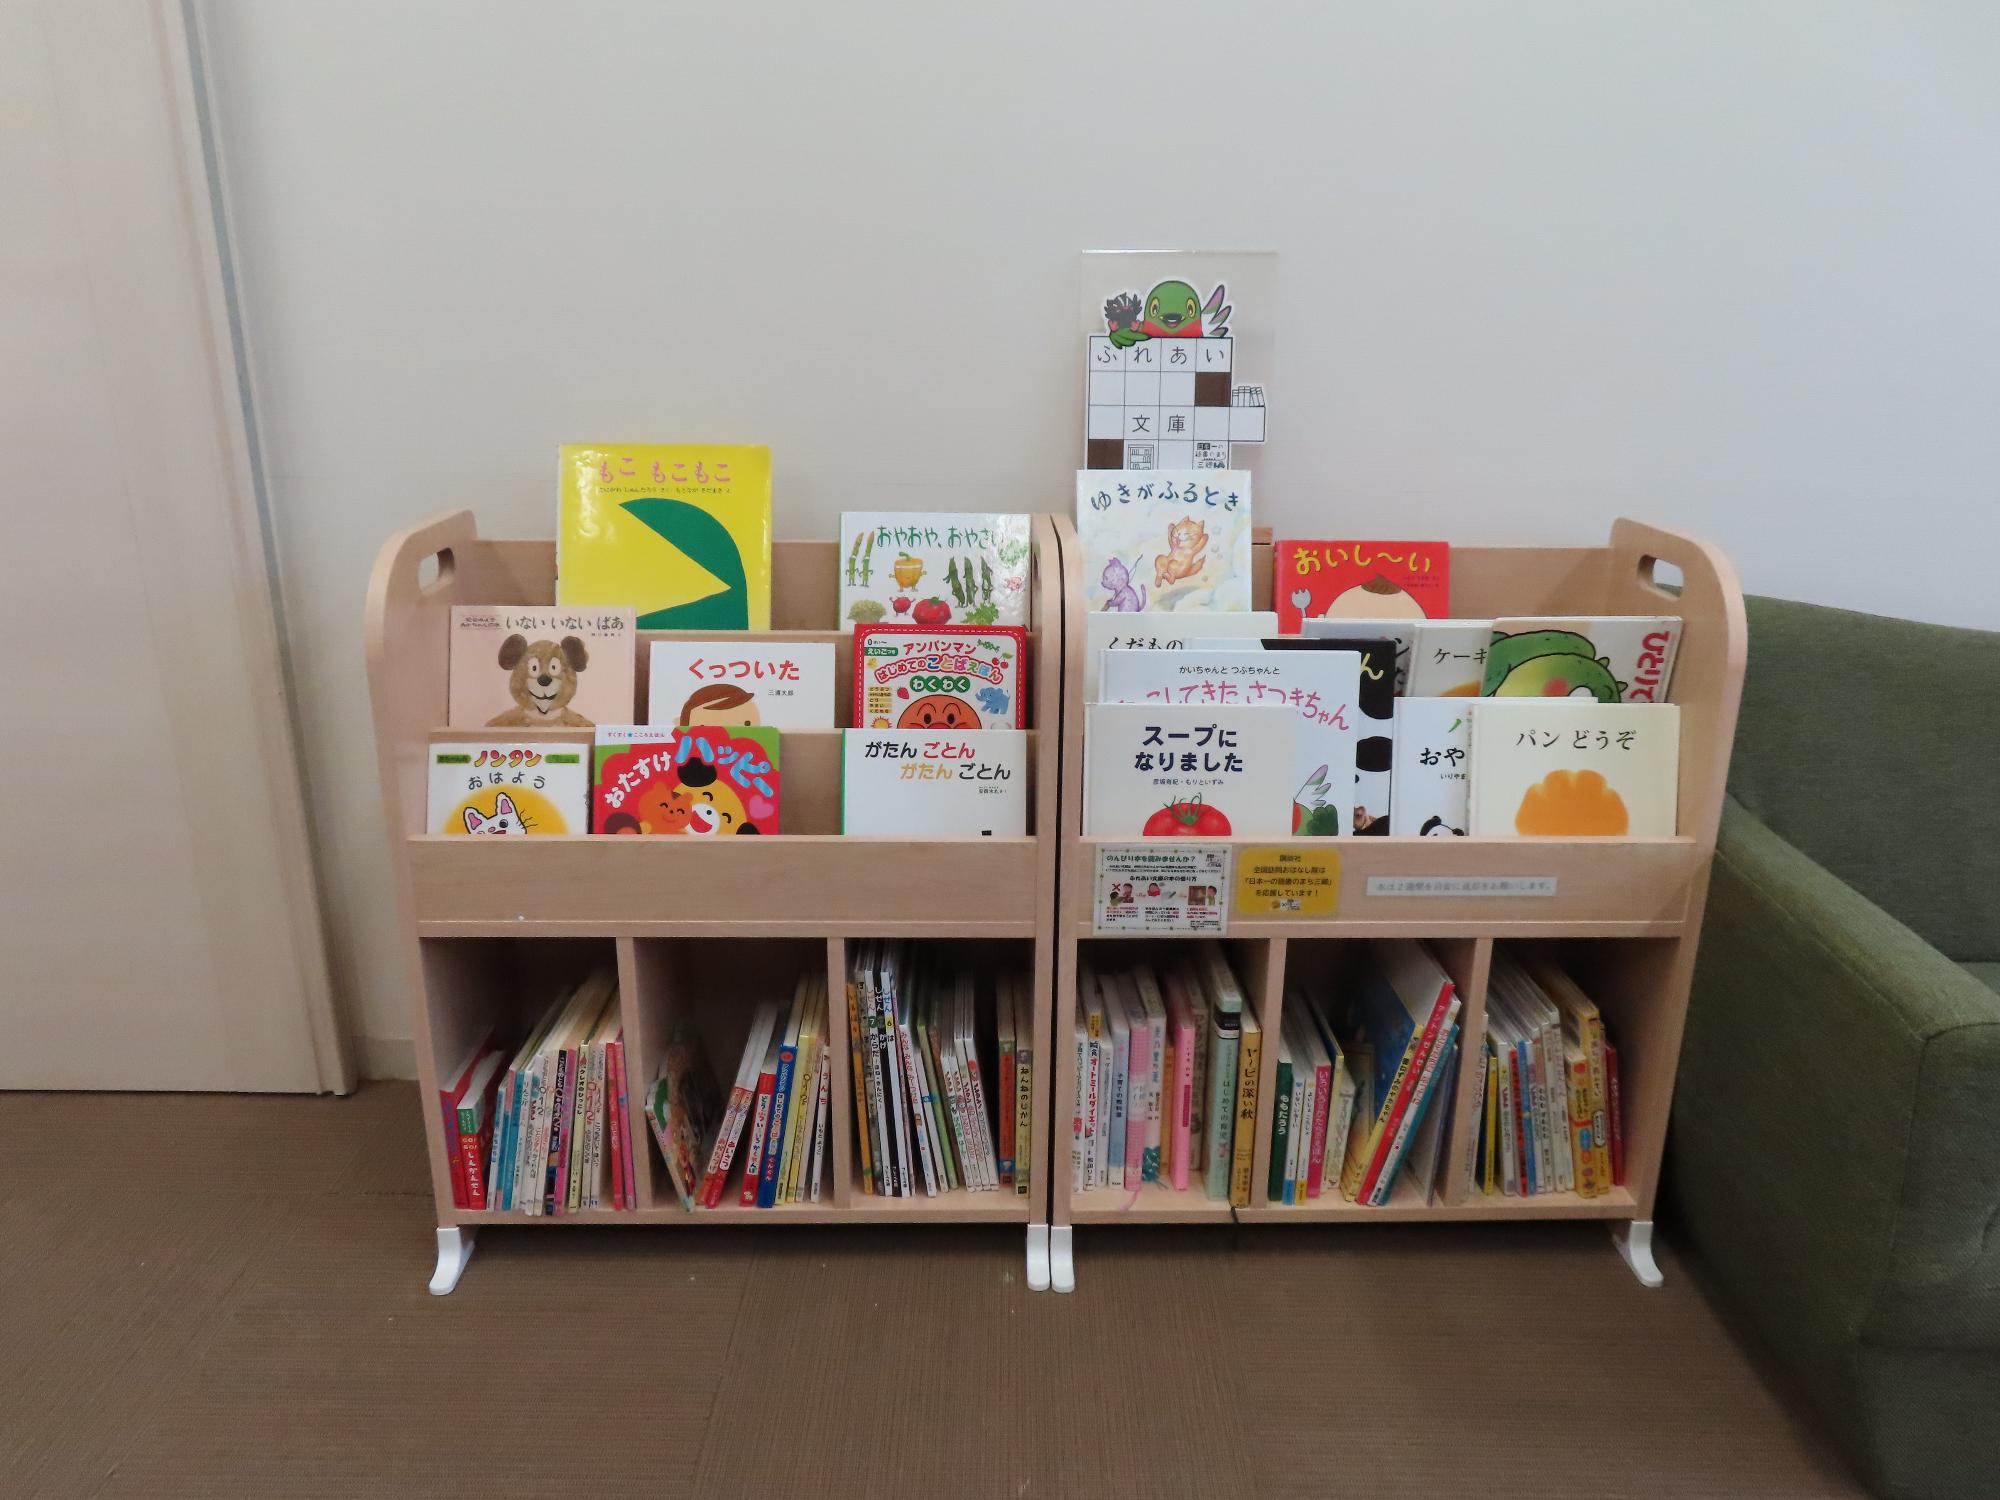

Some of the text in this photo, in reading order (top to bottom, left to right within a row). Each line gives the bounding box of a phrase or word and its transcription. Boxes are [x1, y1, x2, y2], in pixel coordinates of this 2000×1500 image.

[1097, 346, 1224, 365] ふれあい
[1132, 414, 1186, 433] 文庫
[600, 457, 731, 484] もこ もこもこ
[1090, 481, 1239, 512] ゆきがふるとき
[506, 615, 624, 631] いない いない ばあ
[903, 641, 977, 655] アンパンマン
[1432, 647, 1488, 665] ケーキ
[689, 658, 800, 681] くっついた
[876, 656, 1002, 683] はじめてのことばえほん
[1179, 665, 1280, 675] かいちゃんと つぶちゃんと
[912, 678, 967, 690] わくわく
[1142, 723, 1238, 748] スープに
[1516, 729, 1637, 750] パン どうぞ
[474, 749, 543, 768] ノンタン
[865, 741, 976, 759] がたん ごとん
[1419, 747, 1465, 766] おや
[604, 735, 774, 808] おたすけ ハッピー
[900, 763, 1011, 780] がたん ごとん
[1134, 752, 1243, 773] なりました
[467, 770, 546, 790] おはよう
[1019, 1066, 1030, 1127] ねんねのじかん
